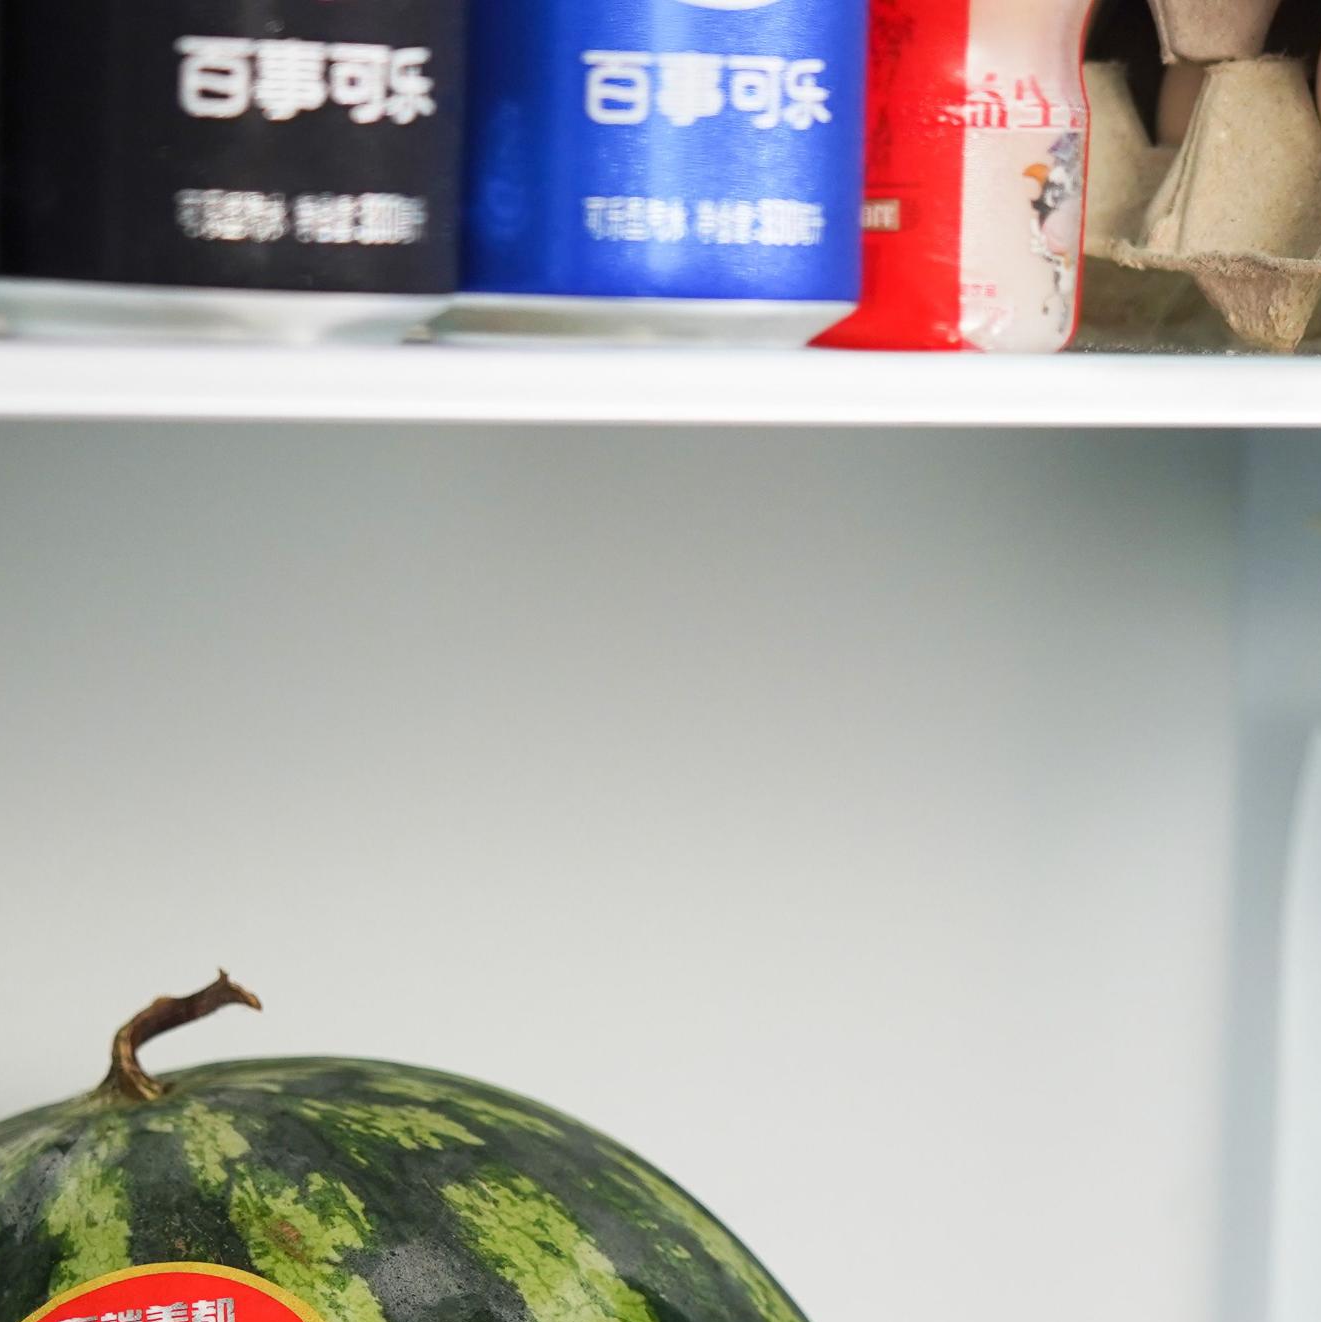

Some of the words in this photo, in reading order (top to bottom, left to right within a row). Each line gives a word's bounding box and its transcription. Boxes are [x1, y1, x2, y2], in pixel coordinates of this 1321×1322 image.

[175, 34, 436, 124] 百事可乐
[581, 48, 831, 130] 百事可乐
